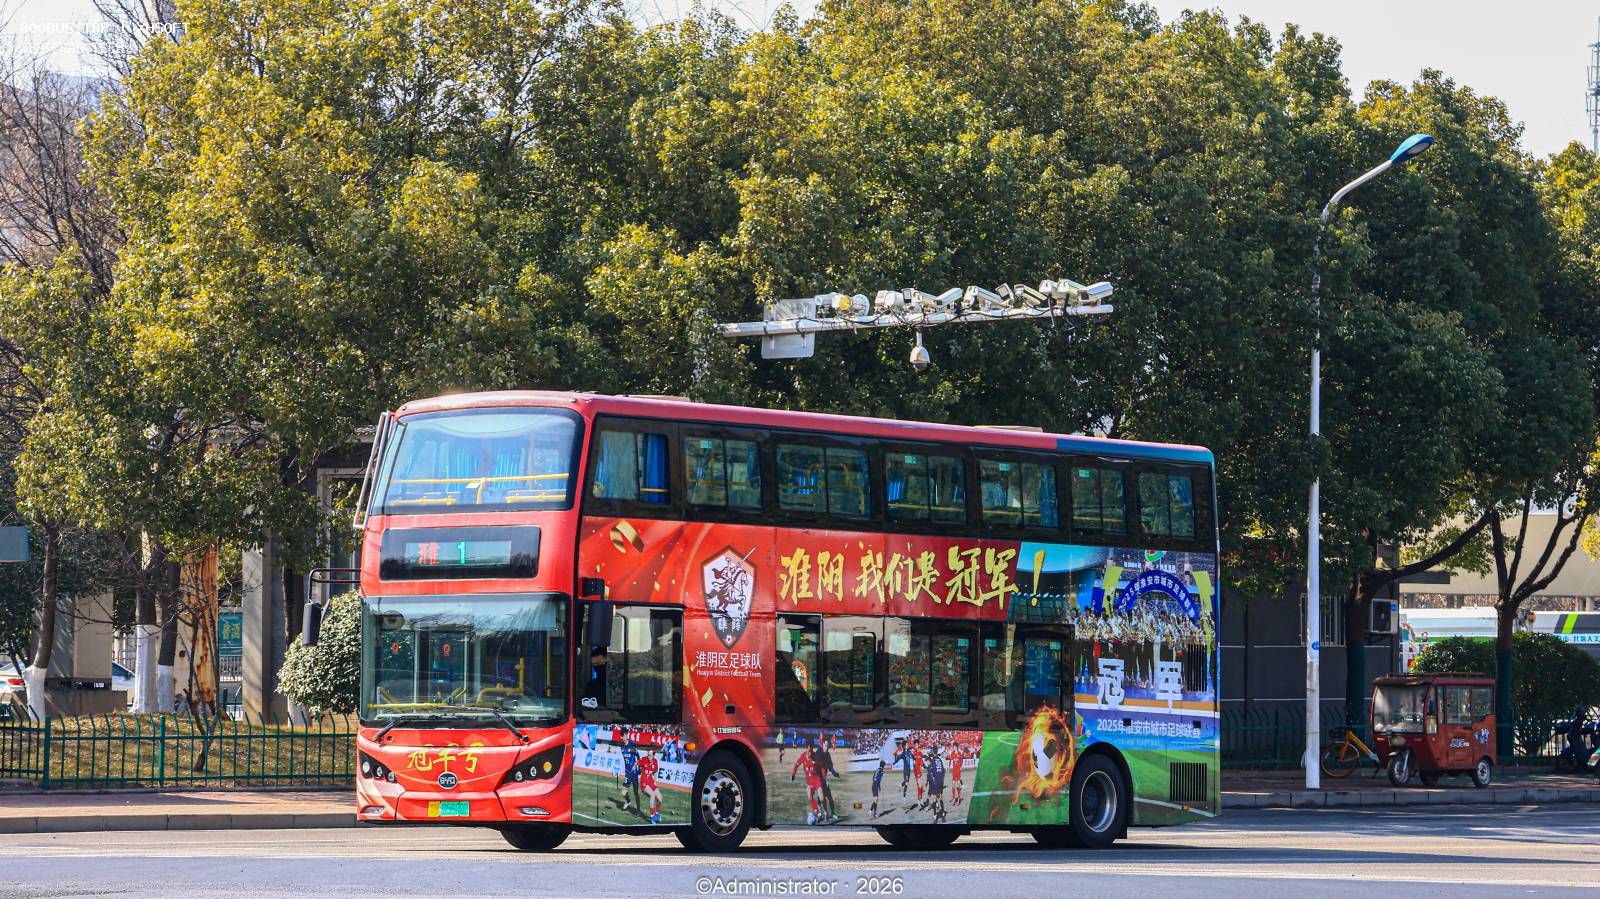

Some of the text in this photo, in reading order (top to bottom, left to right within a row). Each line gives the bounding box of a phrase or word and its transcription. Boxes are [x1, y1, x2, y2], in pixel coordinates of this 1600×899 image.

[695, 651, 762, 669] 淮阴区足球队
